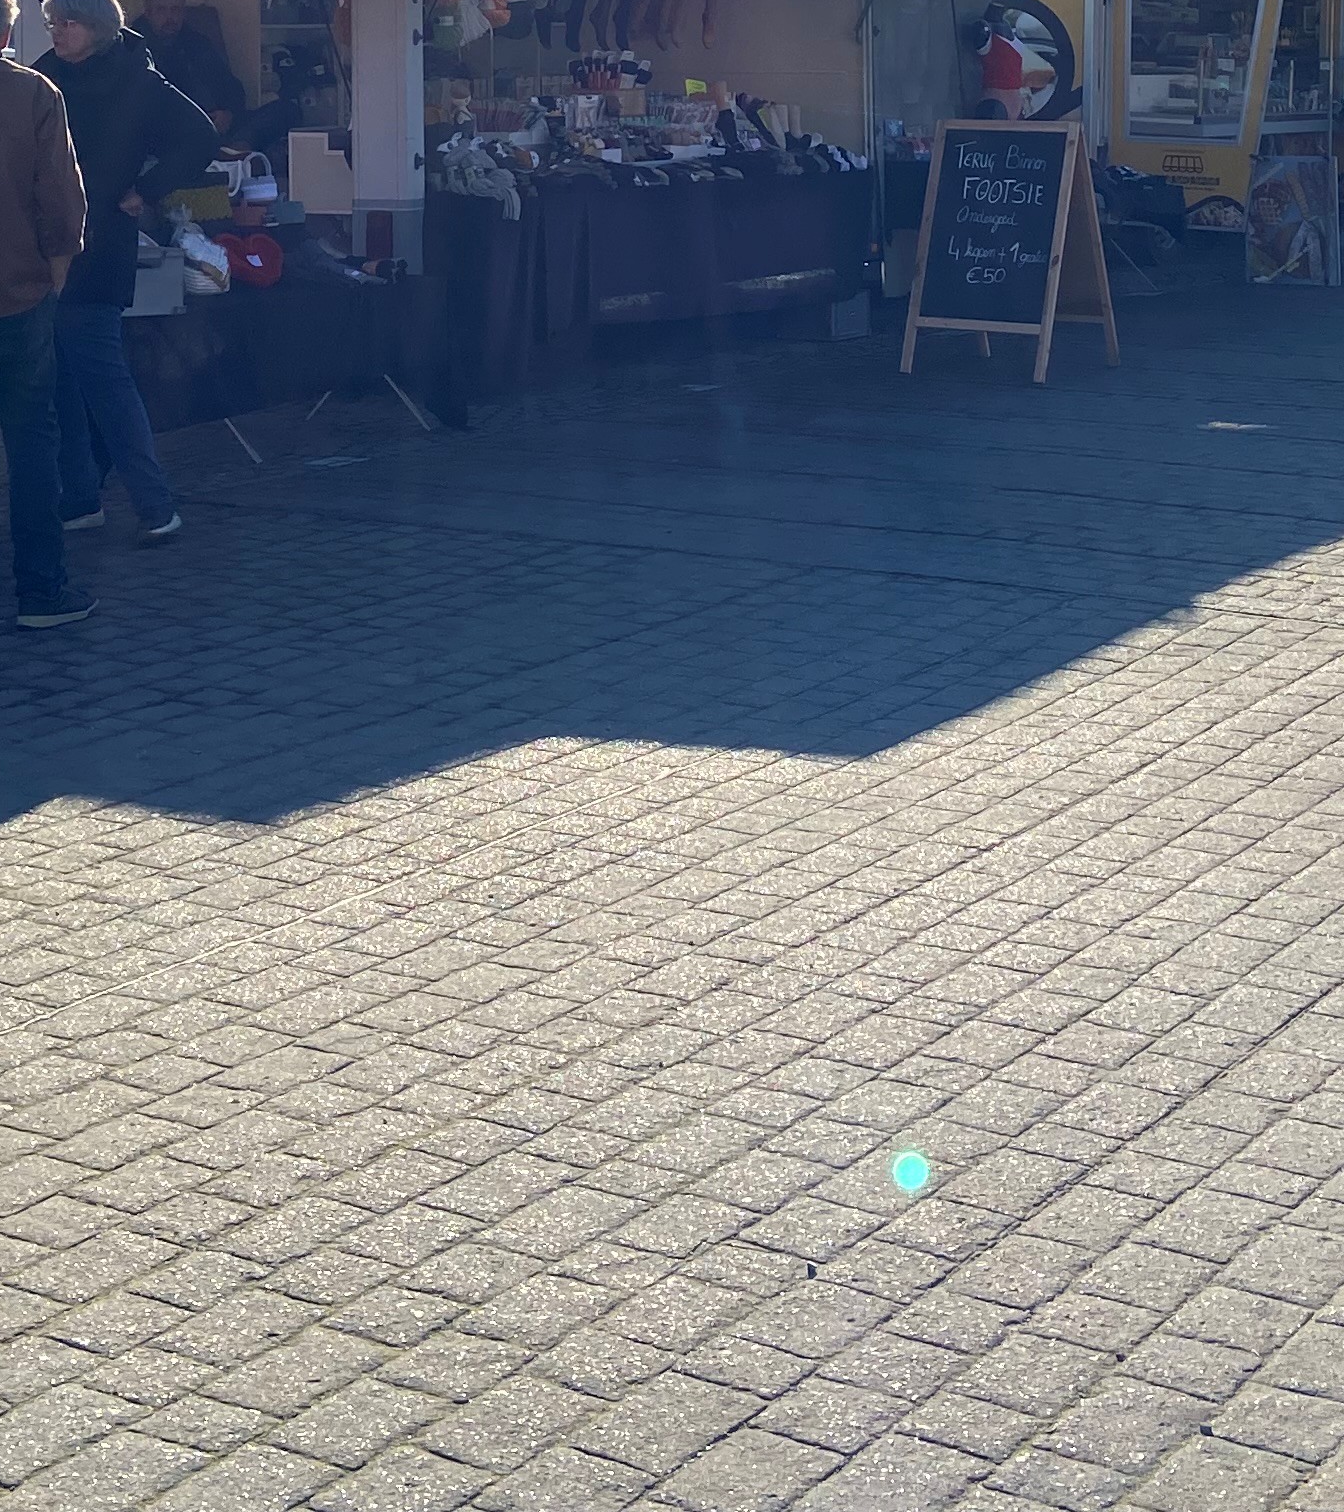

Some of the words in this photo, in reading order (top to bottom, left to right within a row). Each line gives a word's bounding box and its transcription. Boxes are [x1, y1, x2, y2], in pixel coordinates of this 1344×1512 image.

[963, 176, 1044, 205] FOOTSIE
[948, 235, 959, 261] 4
[1010, 242, 1020, 263] 1
